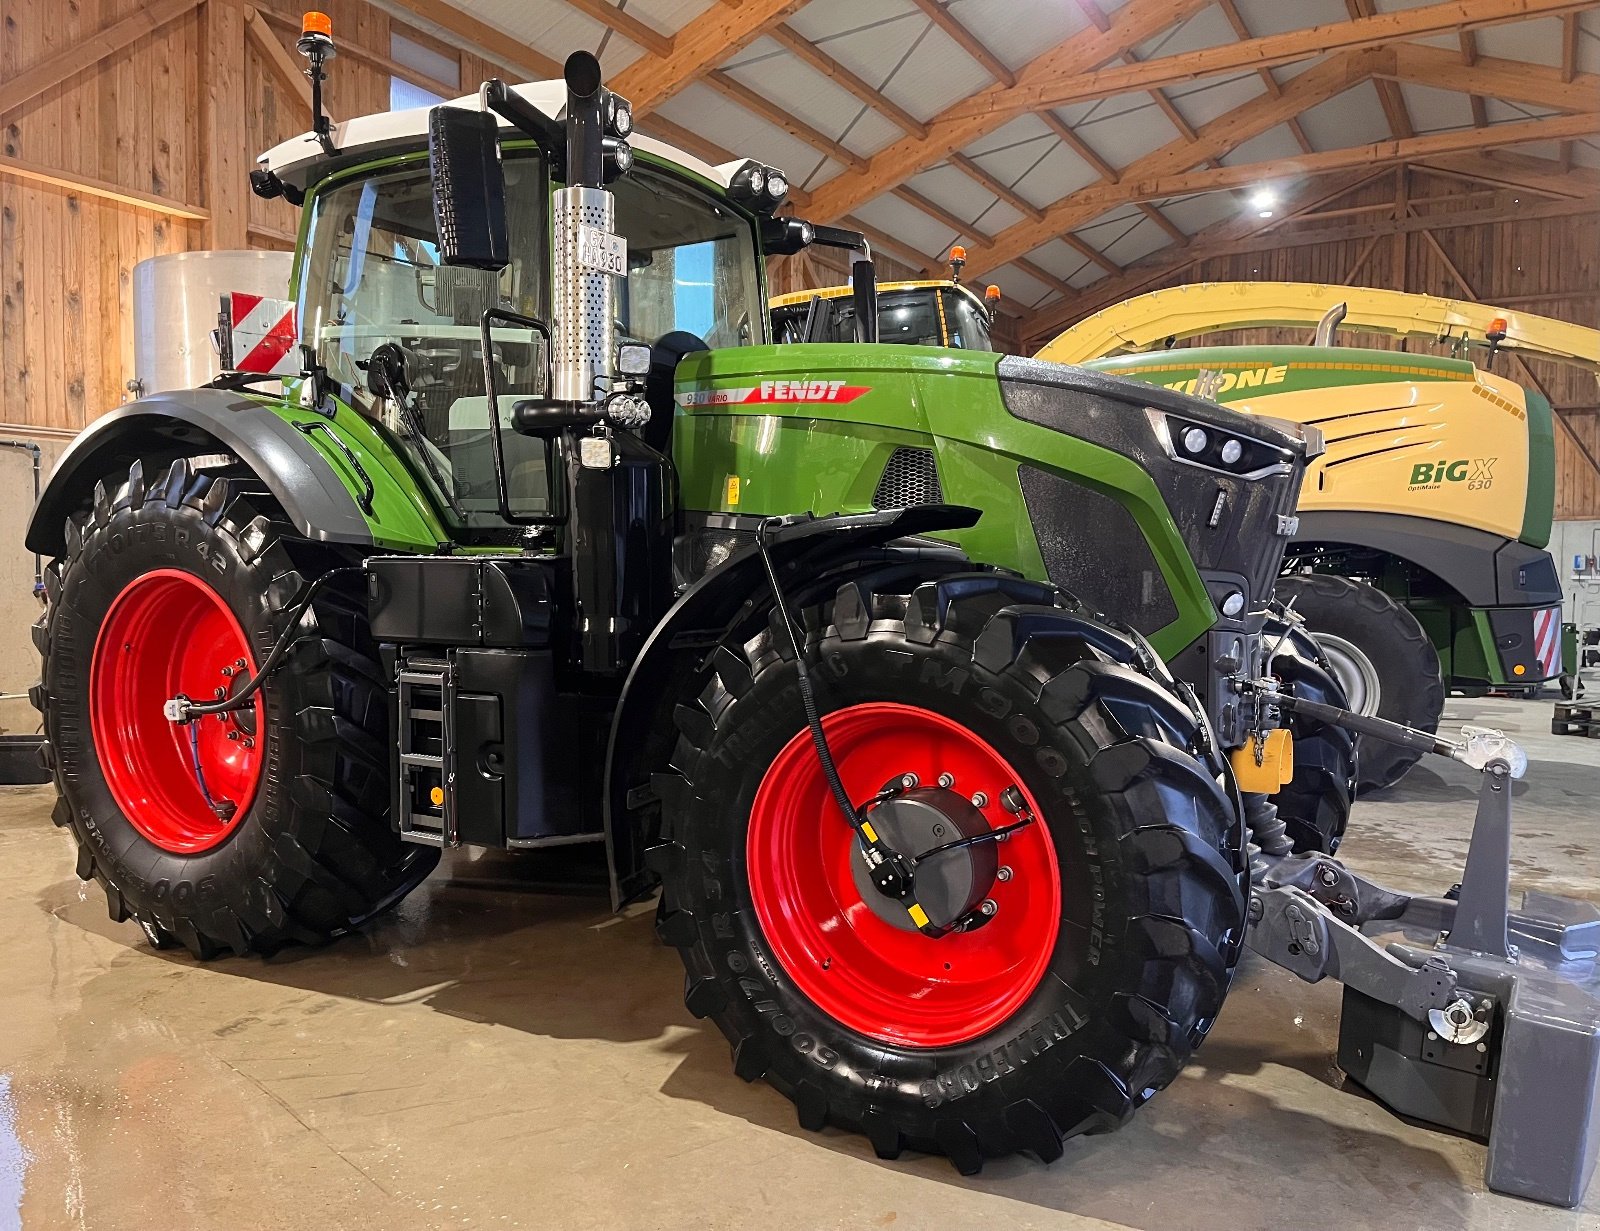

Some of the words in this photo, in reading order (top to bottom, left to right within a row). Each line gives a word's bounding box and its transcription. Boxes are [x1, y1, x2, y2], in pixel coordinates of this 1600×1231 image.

[686, 393, 704, 404] 930
[708, 394, 728, 403] VARIO
[760, 380, 847, 400] FENDT
[1467, 457, 1498, 480] X
[1467, 480, 1492, 490] 630
[195, 541, 228, 575] 42
[712, 913, 735, 938] R
[1088, 864, 1106, 967] POWER
[918, 999, 1092, 1110] TRELLEBORG
